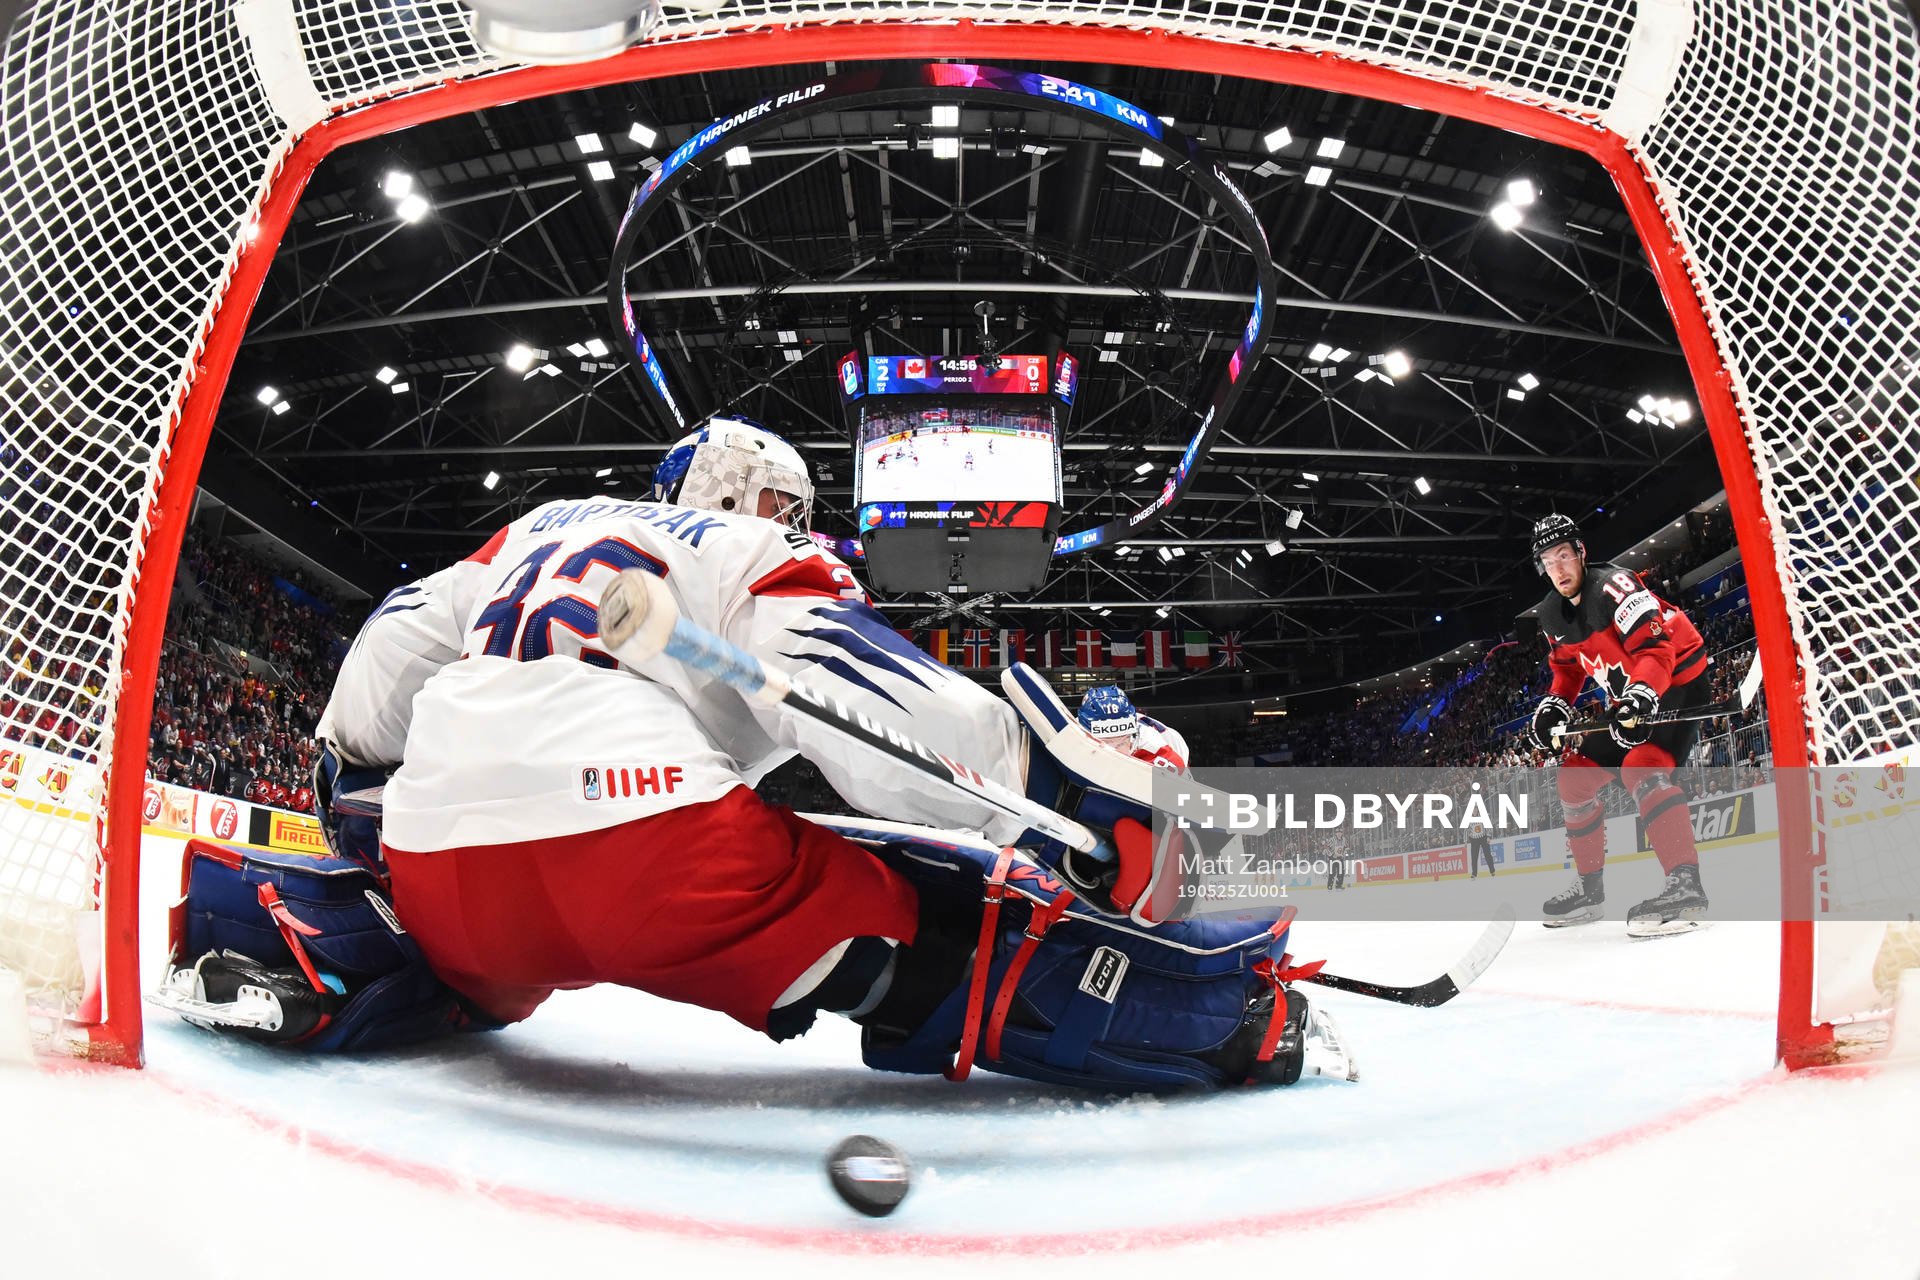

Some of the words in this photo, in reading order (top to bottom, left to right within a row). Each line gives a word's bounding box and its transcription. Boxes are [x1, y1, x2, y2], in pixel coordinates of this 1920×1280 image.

[1041, 80, 1097, 106] 2.41
[1116, 103, 1148, 128] KM
[671, 141, 697, 169] #17
[699, 100, 773, 147] HRONEK
[775, 83, 826, 109] FILIP
[876, 365, 889, 381] 2
[1026, 365, 1039, 381] 0
[889, 511, 908, 520] #17
[909, 511, 950, 519] HRONEK
[951, 510, 974, 519] FILIP
[1129, 502, 1157, 527] LONGEST
[1082, 532, 1097, 545] KM
[1538, 532, 1560, 546] TELUS
[1602, 571, 1636, 605] 18
[606, 765, 683, 798] IIHF
[214, 801, 230, 836] 7
[222, 807, 238, 836] DAYS
[1369, 864, 1396, 877] BENZINA
[1412, 858, 1464, 875] #BRATISLAVA
[1096, 955, 1115, 990] CCM
